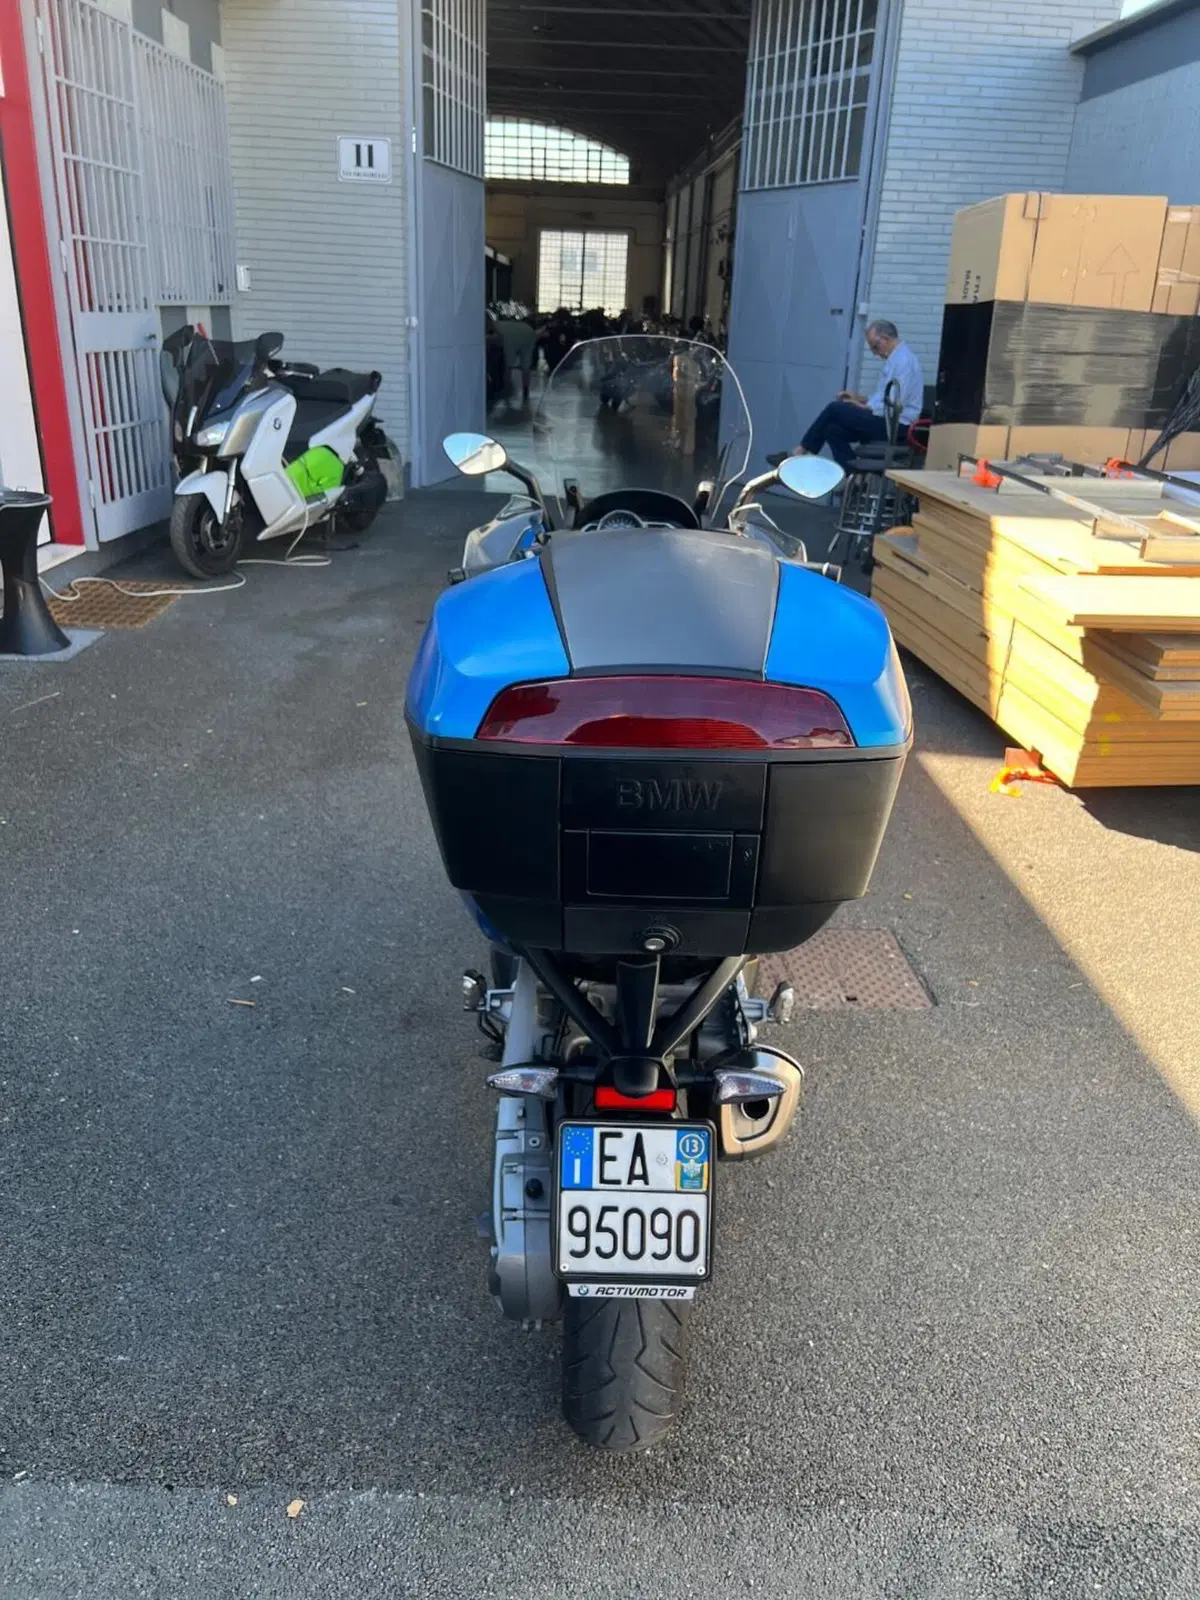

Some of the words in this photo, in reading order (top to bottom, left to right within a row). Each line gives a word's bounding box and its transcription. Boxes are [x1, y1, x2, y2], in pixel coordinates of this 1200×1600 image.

[617, 778, 724, 812] BMW
[599, 1131, 650, 1186] EA
[685, 1139, 699, 1153] 13
[573, 1158, 581, 1185] I
[567, 1205, 700, 1262] 95090
[595, 1286, 687, 1297] ACTIVMOTOR
